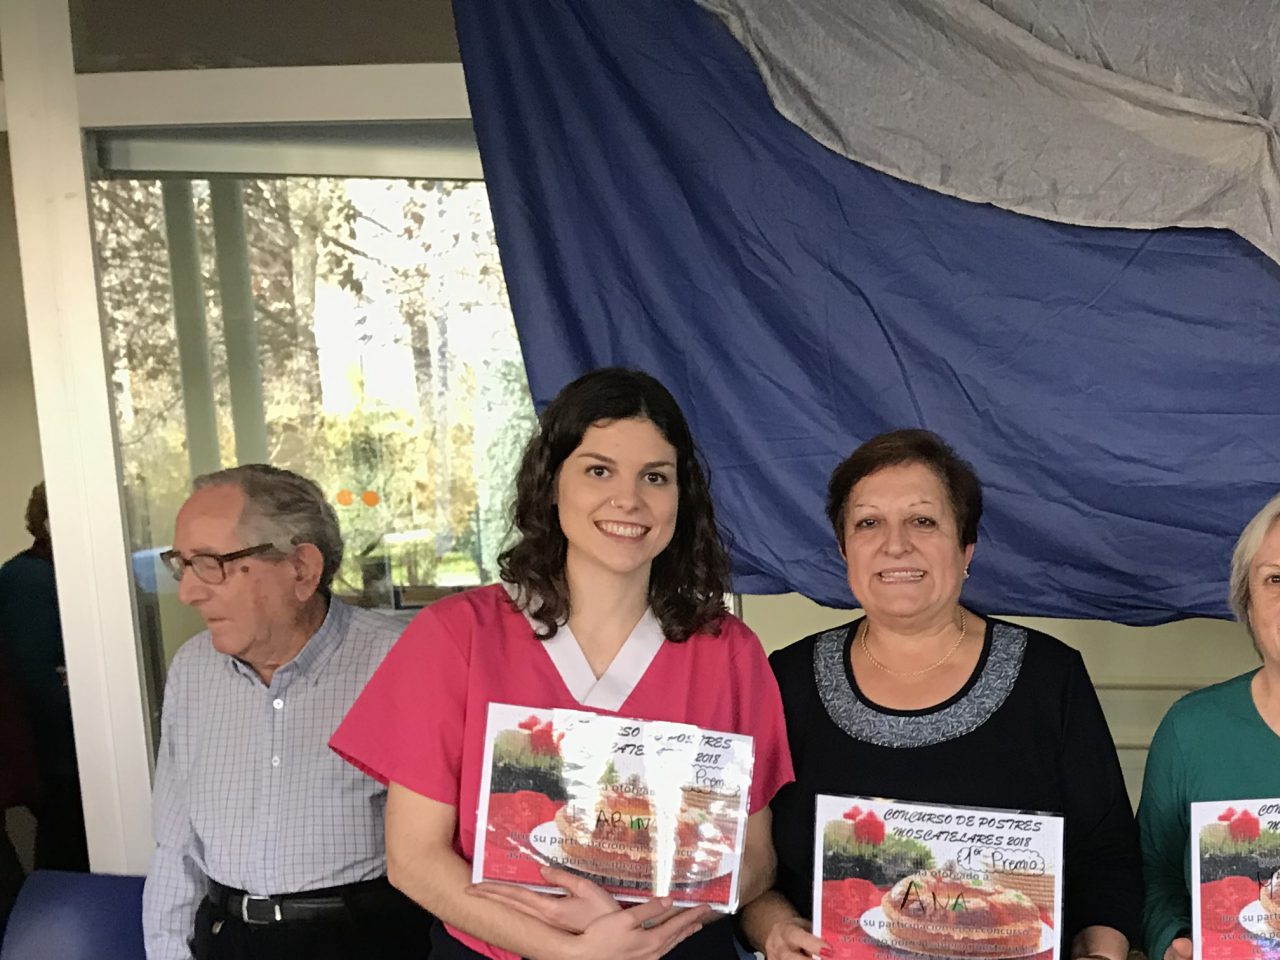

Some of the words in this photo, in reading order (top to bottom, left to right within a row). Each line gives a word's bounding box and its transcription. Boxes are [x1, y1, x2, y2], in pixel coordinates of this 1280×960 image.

[695, 752, 721, 764] 2018
[884, 808, 952, 824] CONCURSO
[955, 815, 975, 827] DE
[979, 817, 1043, 832] POSTRES
[533, 834, 546, 843] su
[893, 826, 1003, 846] MOSCATELARES
[1006, 836, 1032, 847] 2018
[992, 851, 1037, 871] Premio
[900, 881, 969, 913] ANA
[863, 919, 875, 927] su
[1242, 914, 1254, 922] su
